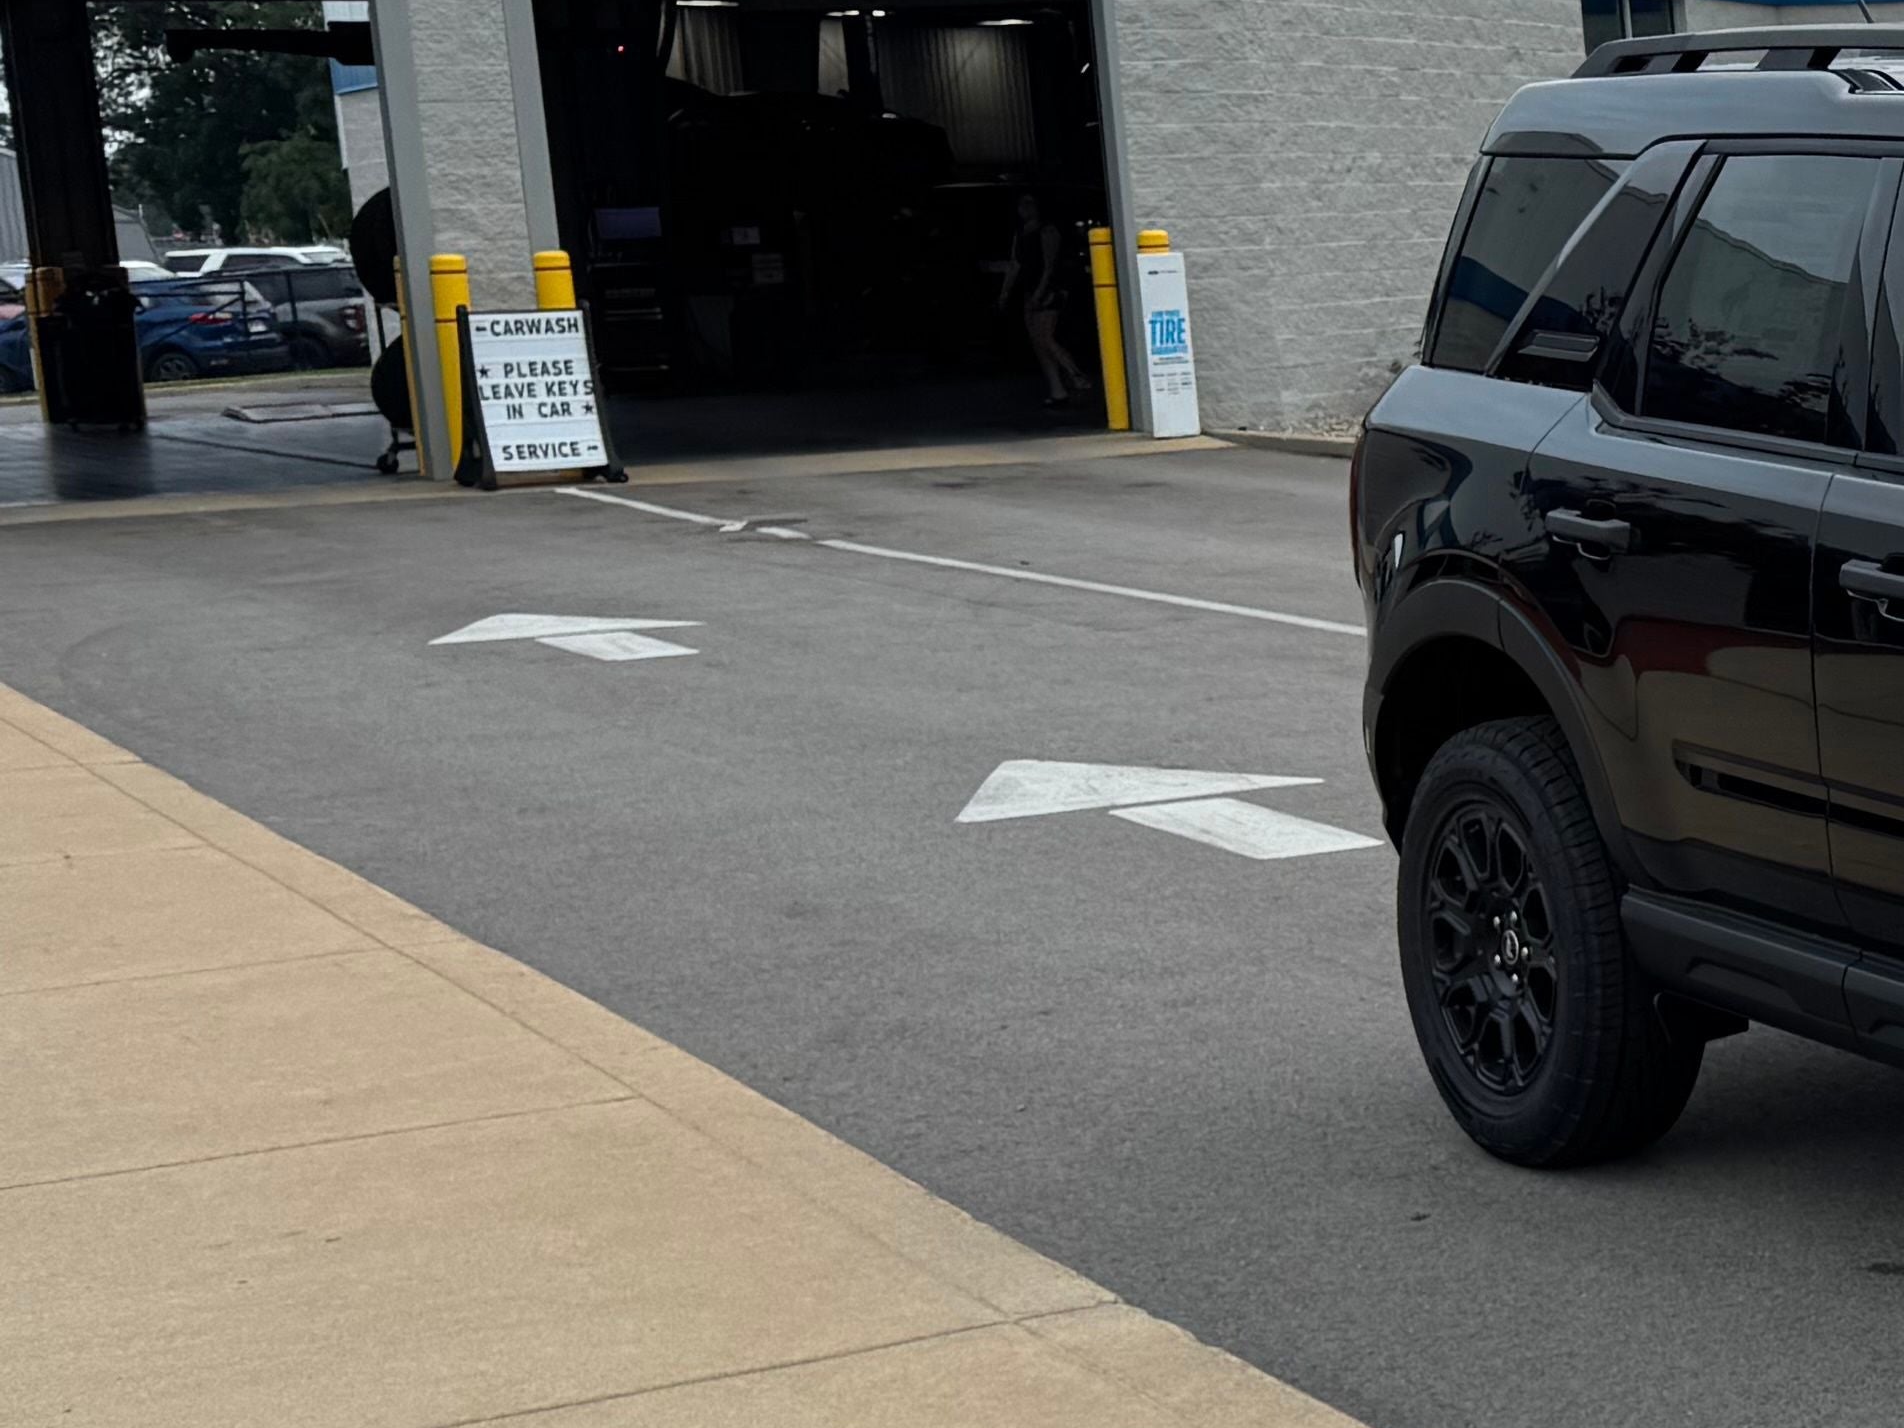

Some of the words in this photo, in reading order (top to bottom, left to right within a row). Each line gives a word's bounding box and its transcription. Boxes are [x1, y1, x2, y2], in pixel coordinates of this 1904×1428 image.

[490, 316, 579, 337] CARWASH
[1148, 318, 1186, 346] TIRE
[503, 359, 574, 379] PLEASE
[479, 381, 537, 401] LEAVE
[545, 379, 595, 398] KEYS
[506, 403, 524, 420] IN
[537, 401, 572, 418] CAR
[502, 440, 581, 461] SERVICE
